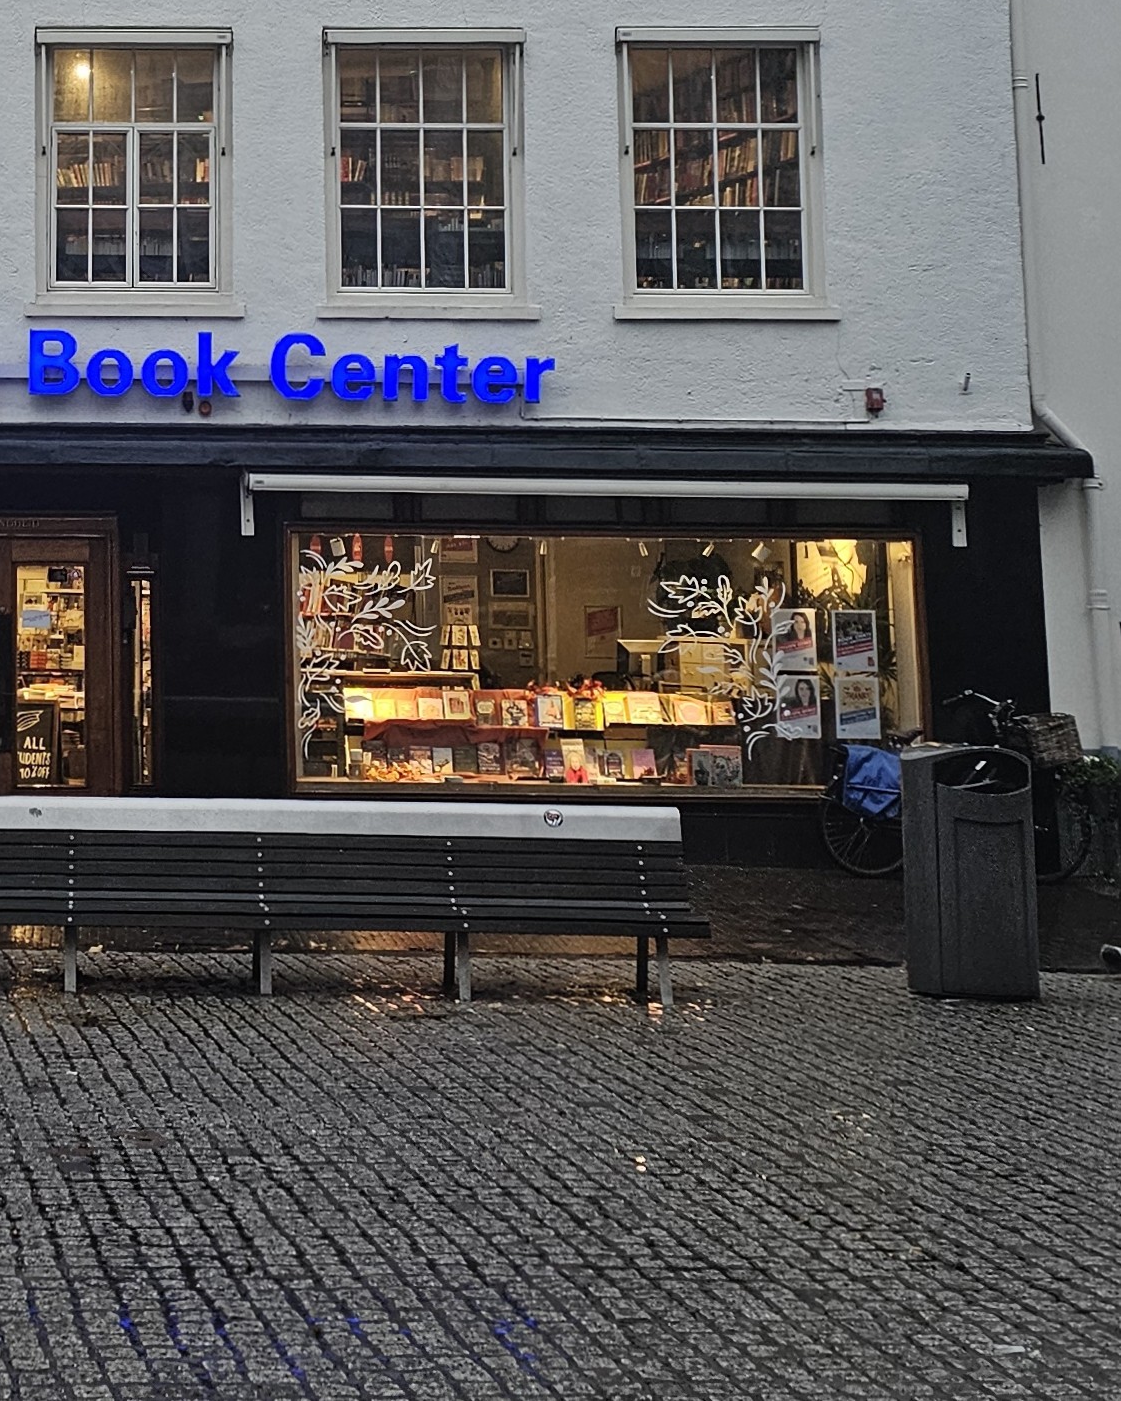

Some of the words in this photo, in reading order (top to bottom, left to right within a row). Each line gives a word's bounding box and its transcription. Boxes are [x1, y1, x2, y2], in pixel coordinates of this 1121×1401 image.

[25, 328, 241, 398] Book
[267, 332, 557, 405] Center
[23, 736, 46, 751] ALL
[17, 751, 51, 766] UDENTS
